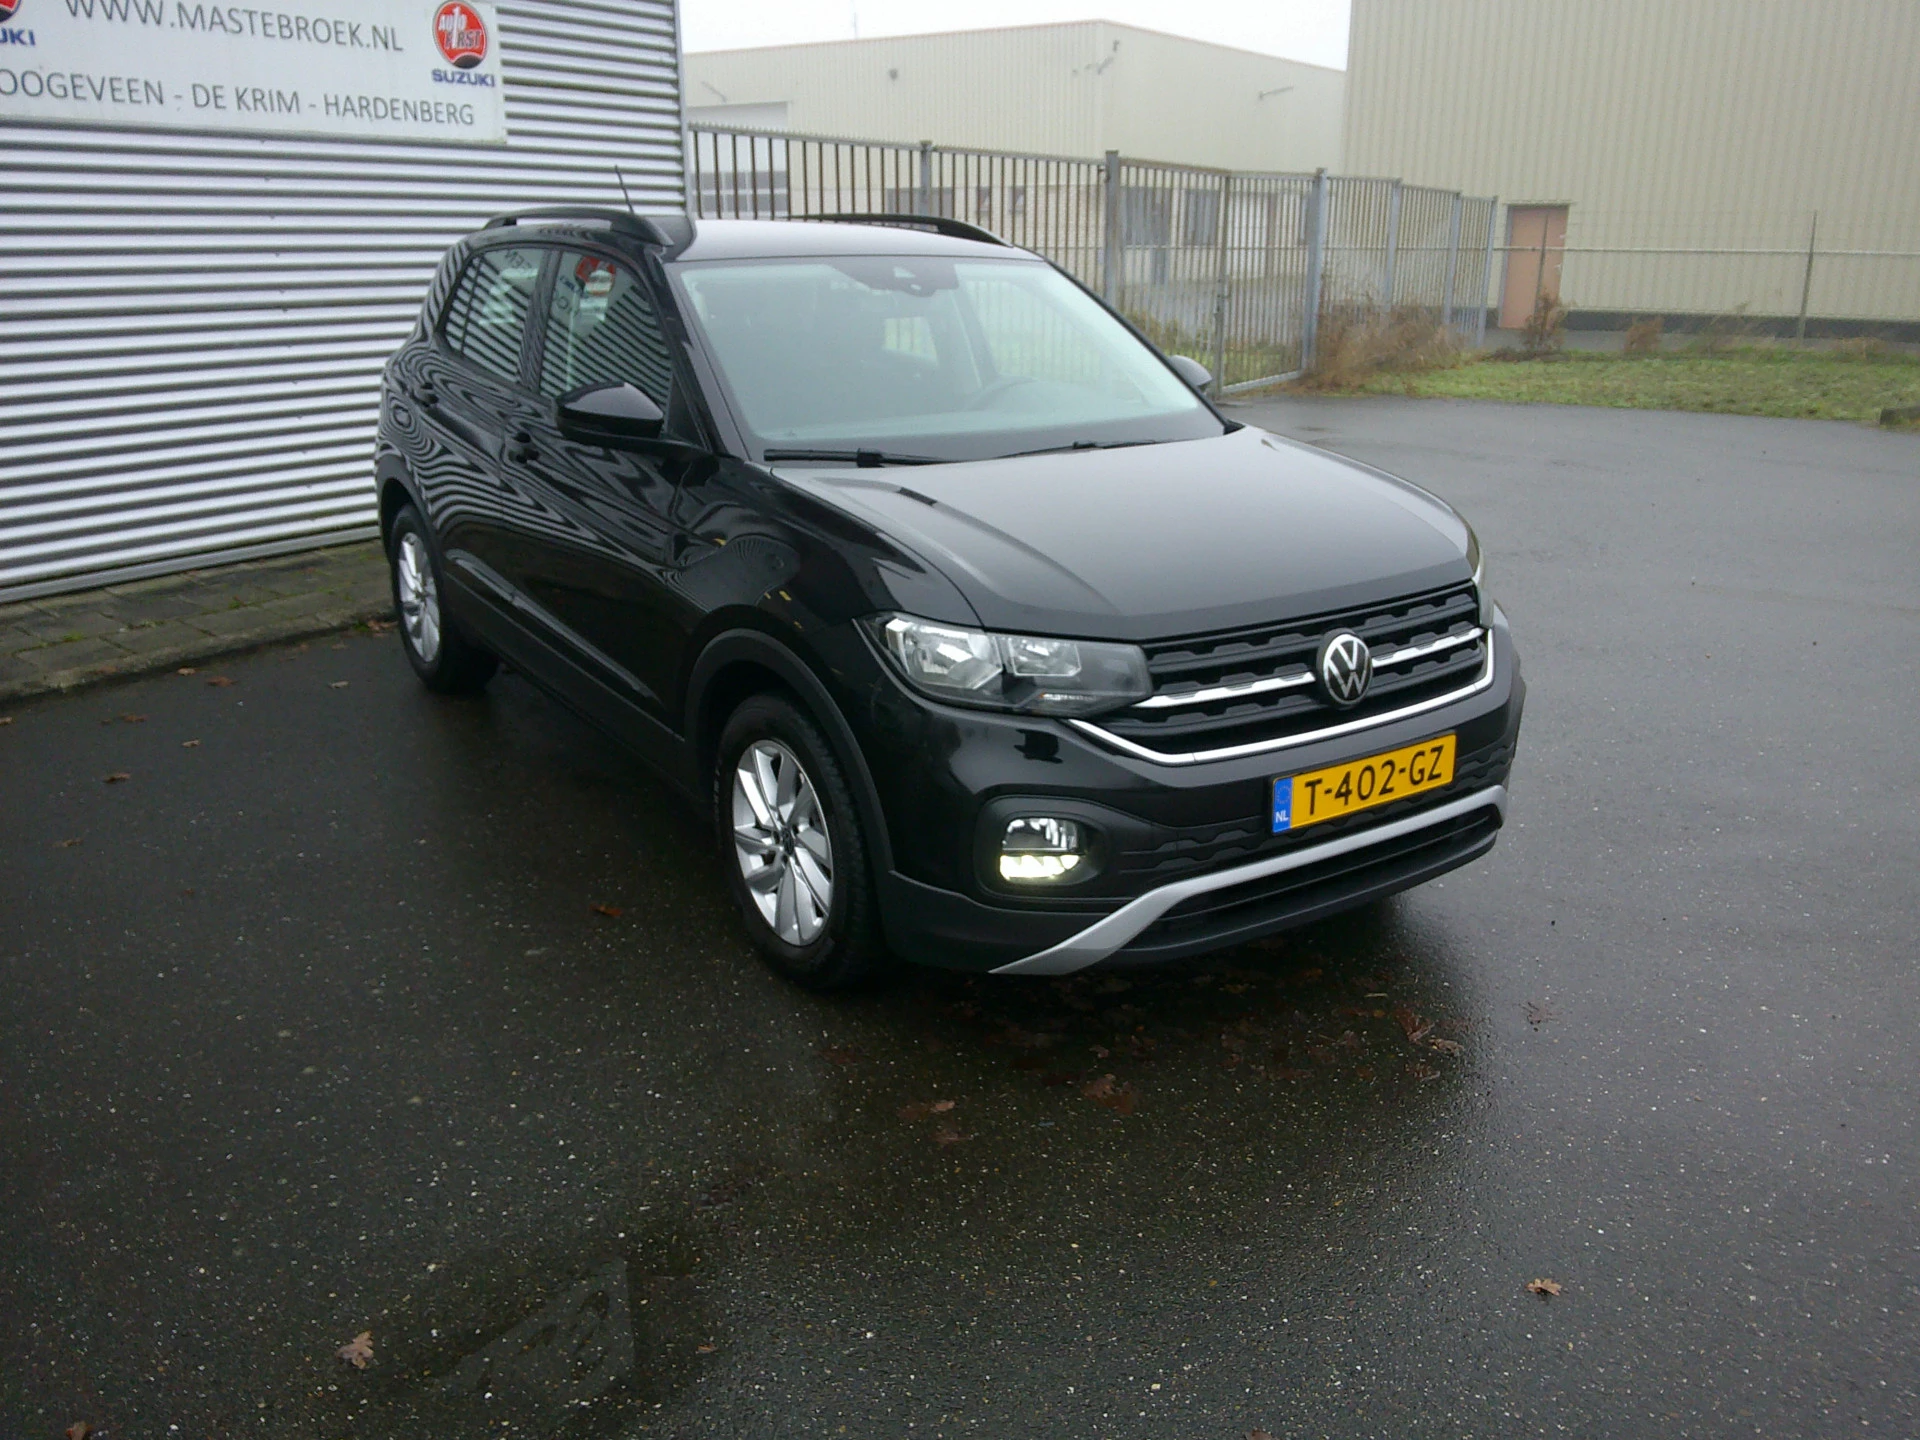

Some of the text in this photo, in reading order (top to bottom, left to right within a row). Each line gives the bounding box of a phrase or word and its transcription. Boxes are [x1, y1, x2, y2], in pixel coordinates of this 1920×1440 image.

[65, 0, 404, 51] WWW.MASTEBROEK.NL
[431, 68, 495, 88] SUZUKI
[191, 83, 227, 110] DE
[235, 86, 300, 114] KRIM
[323, 93, 474, 126] HARDENBERG
[1304, 745, 1444, 815] T-402-GZ
[1275, 811, 1289, 823] NL
